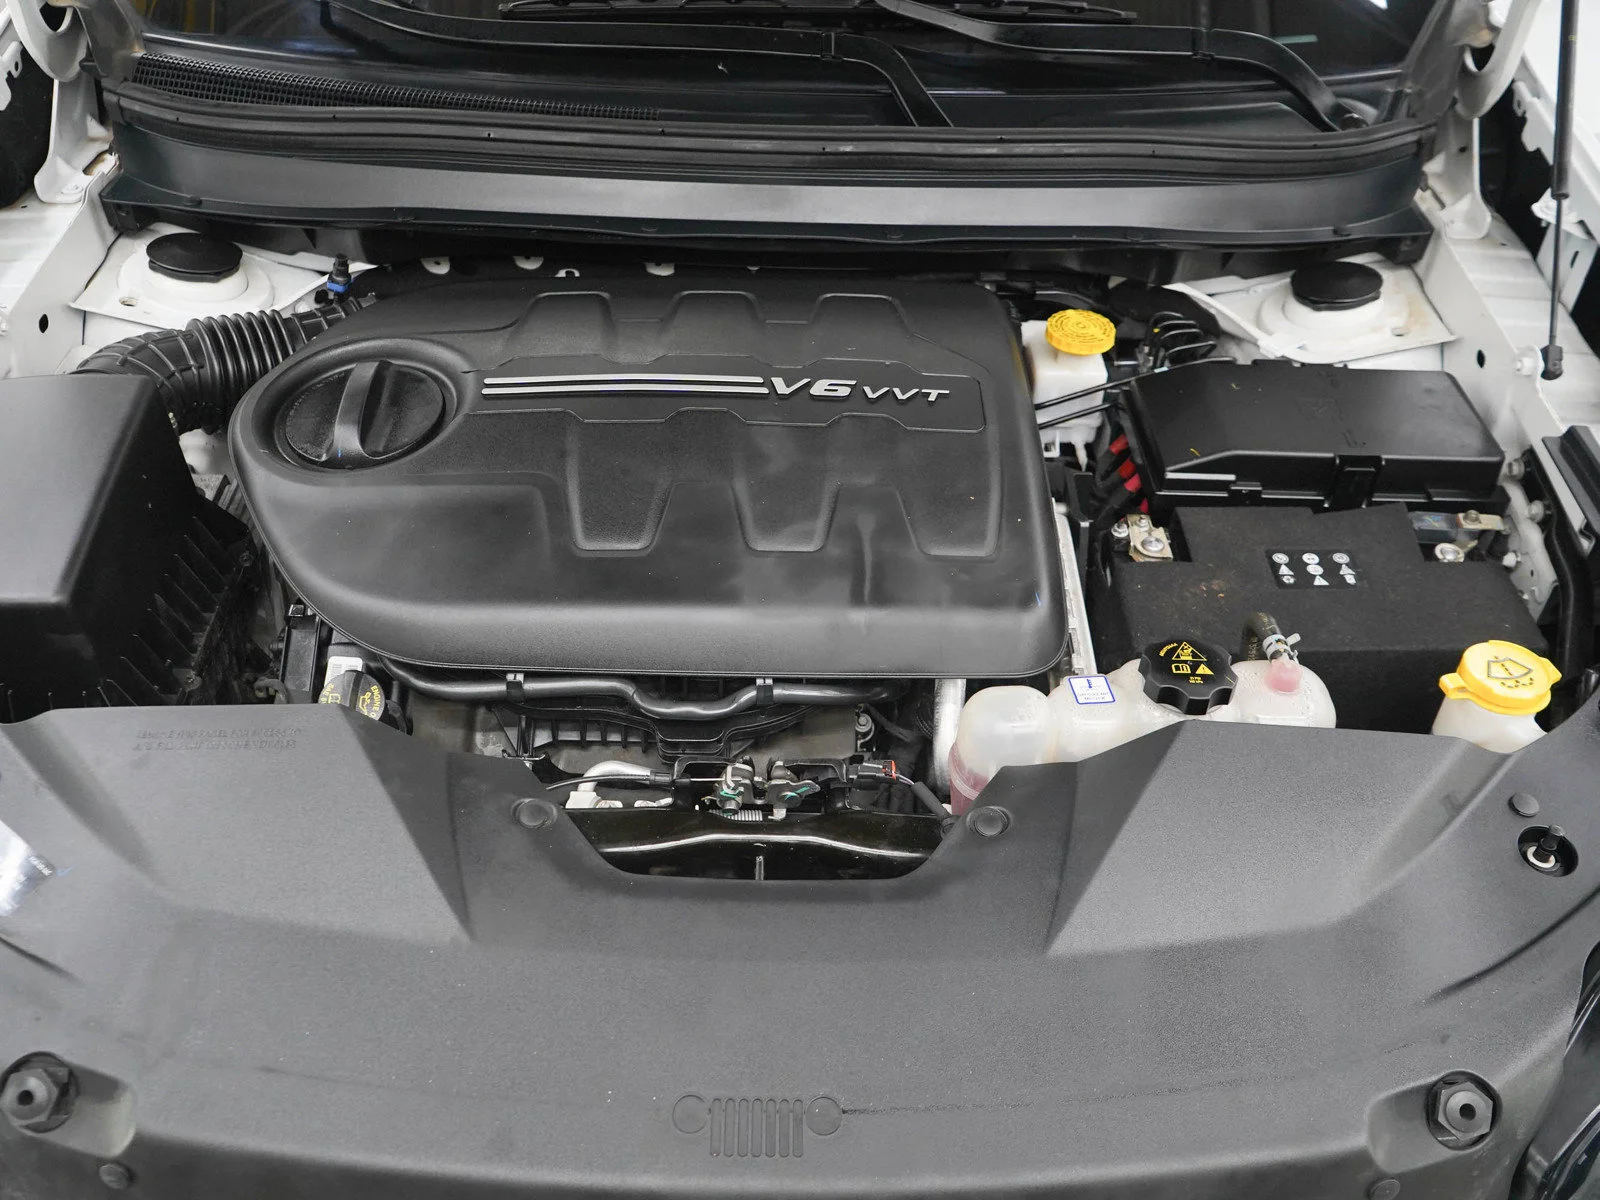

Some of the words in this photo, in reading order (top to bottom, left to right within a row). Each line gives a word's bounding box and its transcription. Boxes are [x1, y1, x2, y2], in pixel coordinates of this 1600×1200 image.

[770, 377, 857, 399] V6
[862, 387, 949, 402] VVT
[370, 685, 381, 711] ENGINE
